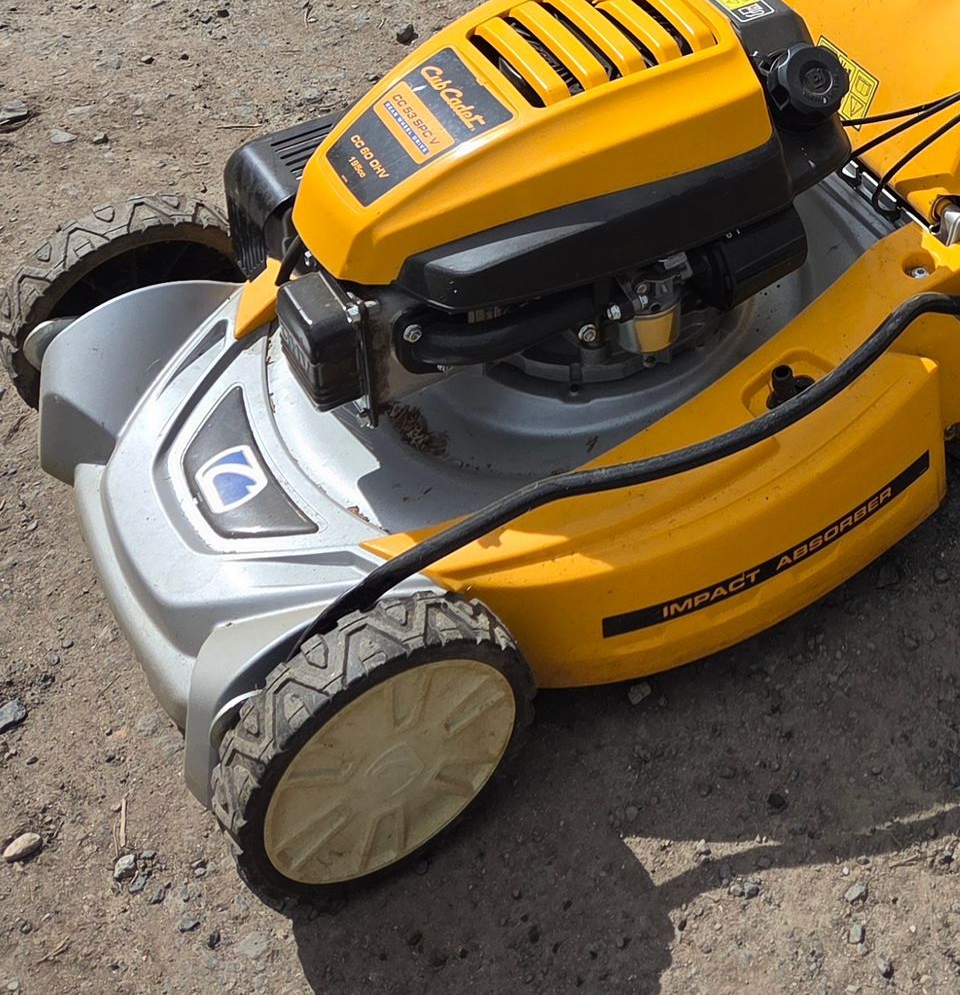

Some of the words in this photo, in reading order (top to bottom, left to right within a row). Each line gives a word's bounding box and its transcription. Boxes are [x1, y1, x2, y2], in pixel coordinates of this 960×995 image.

[392, 94, 406, 108] CC
[402, 106, 416, 121] 53
[414, 119, 433, 138] SPC
[420, 65, 452, 91] Cub
[440, 88, 486, 130] Cadet
[396, 116, 414, 138] WHEEL
[350, 134, 363, 148] CC
[370, 158, 389, 179] OHV
[662, 569, 761, 618] IMPACT
[775, 487, 893, 571] ABSORBER
